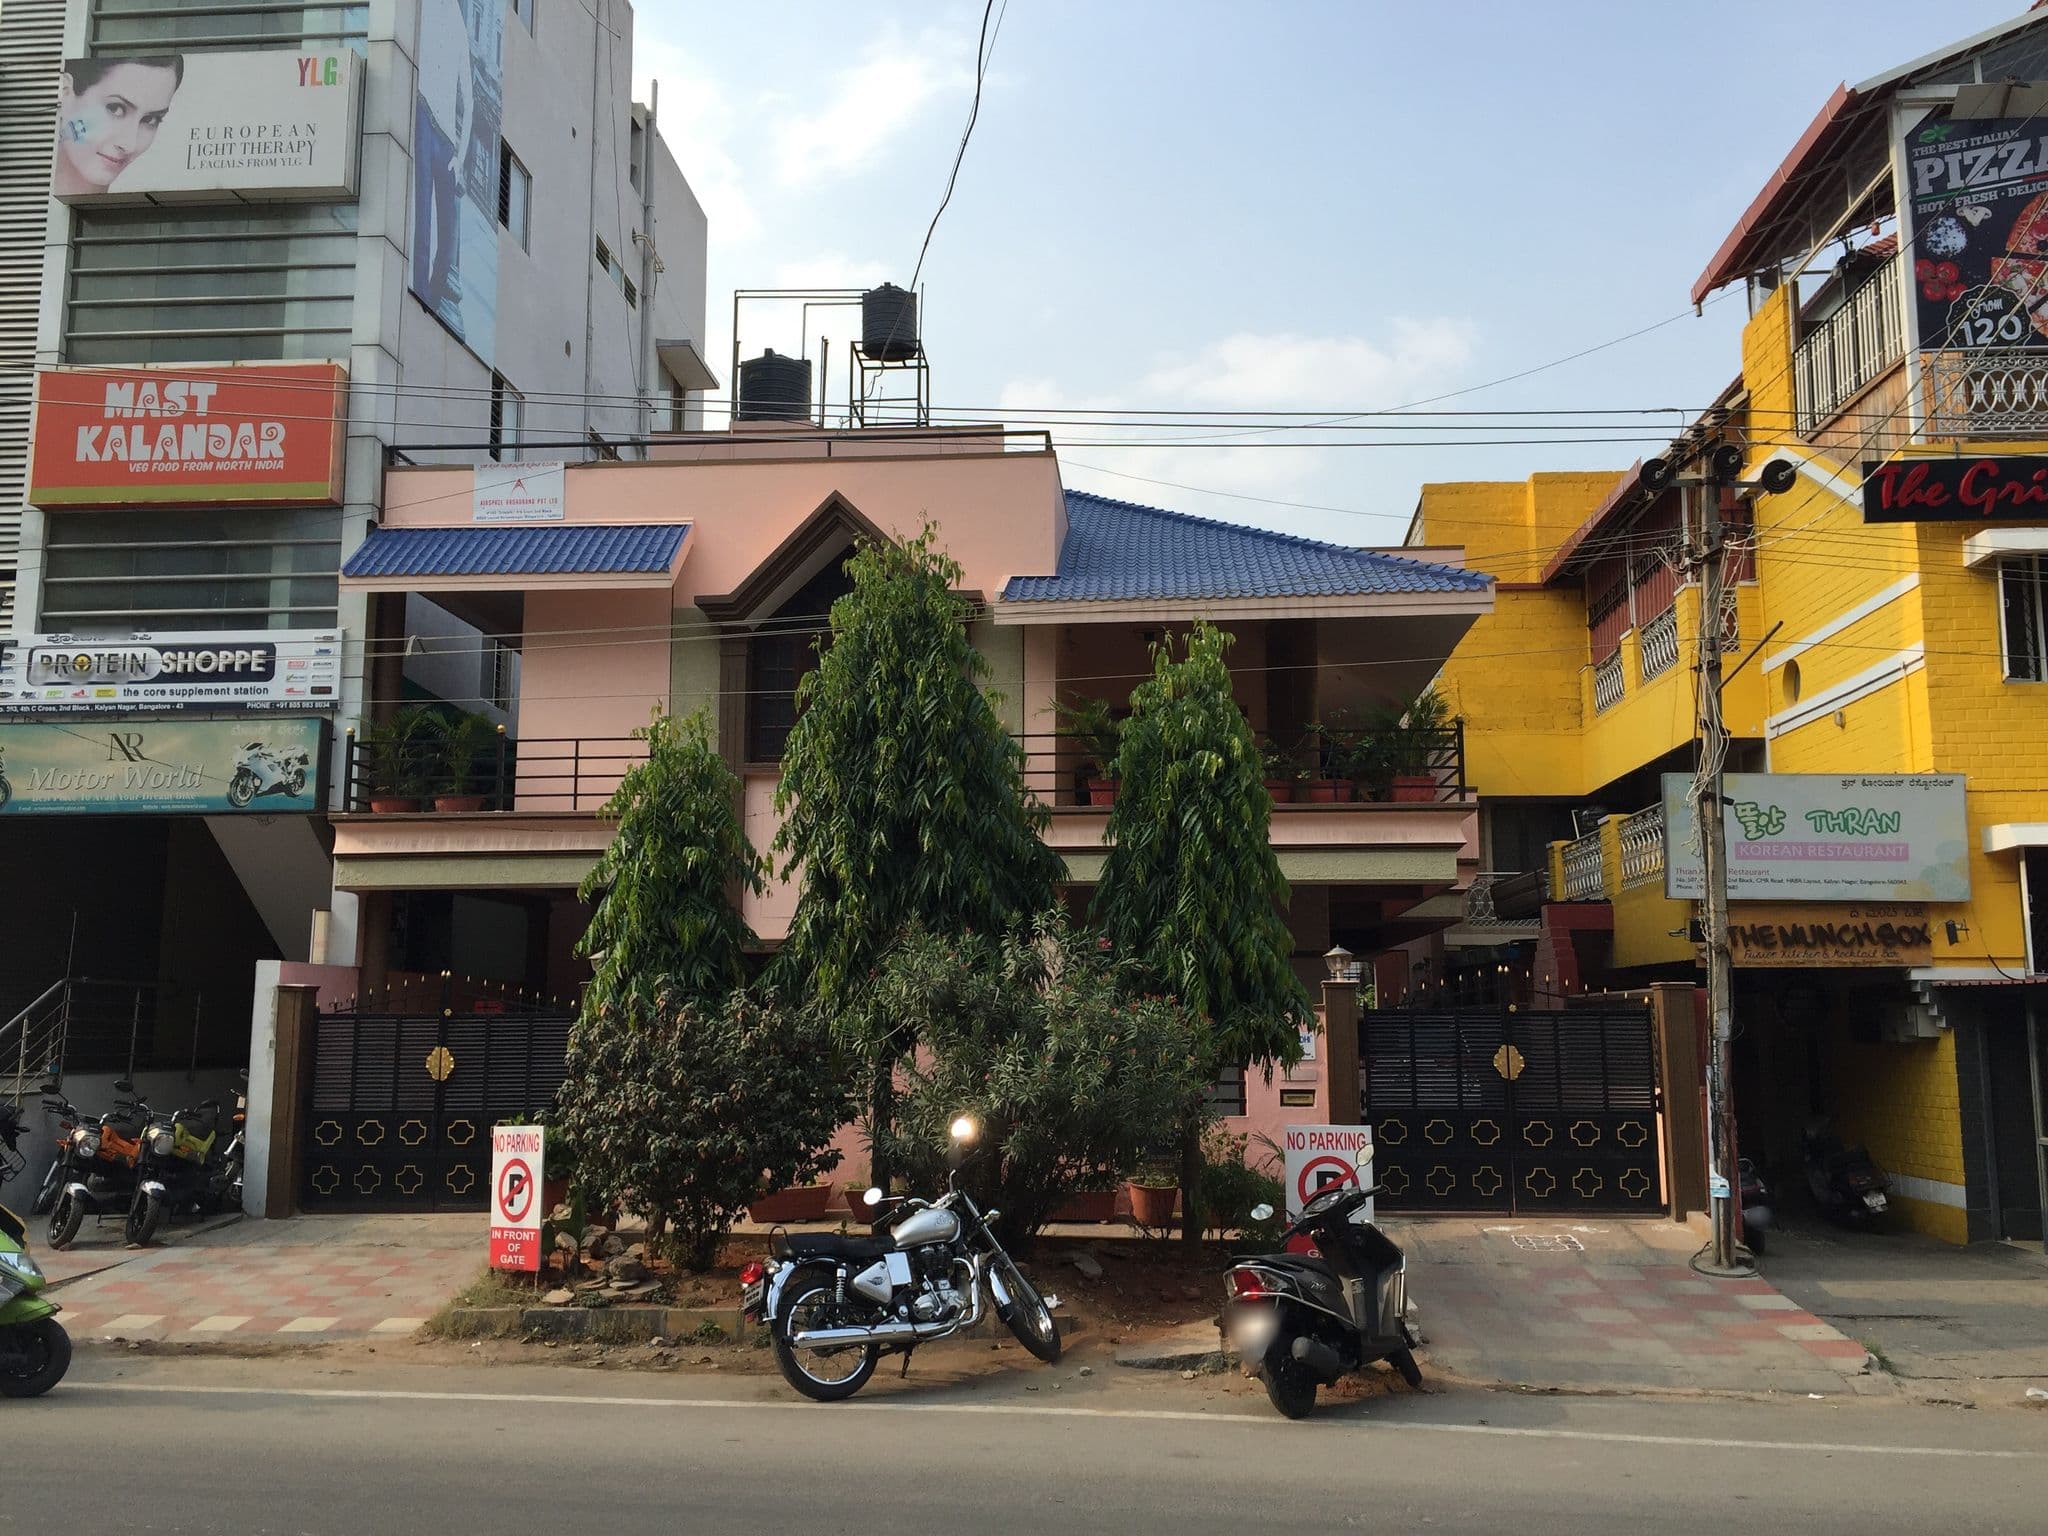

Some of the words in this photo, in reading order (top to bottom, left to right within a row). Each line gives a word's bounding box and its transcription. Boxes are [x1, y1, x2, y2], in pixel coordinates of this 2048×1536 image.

[297, 57, 338, 87] YLG
[190, 123, 317, 140] EUROPEAN
[240, 140, 317, 166] THERAPY
[1912, 145, 1937, 157] THE
[1970, 129, 2020, 147] ITALIAN
[199, 159, 244, 169] FACIALS
[247, 157, 277, 168] FROM
[280, 157, 302, 167] YLG
[1917, 200, 1946, 214] HOT
[1955, 190, 1999, 208] FRESH
[1966, 297, 2004, 319] From
[1959, 314, 2023, 347] 120
[104, 381, 218, 418] MAST
[75, 422, 286, 462] KALANDAR
[129, 463, 148, 473] VEG
[151, 462, 180, 473] FOOD
[182, 461, 213, 472] FROM
[216, 461, 251, 471] NORTH
[254, 460, 284, 470] INDIA
[1874, 462, 1950, 511] The
[161, 649, 268, 673] SHOPPE
[123, 687, 139, 697] the
[143, 688, 166, 697] core
[169, 686, 230, 698] supplement
[234, 685, 269, 696] station
[139, 703, 171, 711] Bangalore
[25, 767, 115, 791] Motor
[122, 763, 205, 790] World
[1805, 807, 1901, 836] THRAN
[1740, 844, 1802, 857] KOREAN
[1808, 845, 1905, 857] RESTAURANT
[1728, 867, 1770, 876] Restaurant
[1726, 923, 1778, 948] THE
[1778, 922, 1878, 948] MUNCH
[1875, 922, 1933, 947] BOX
[494, 1134, 505, 1153] NO
[506, 1133, 540, 1153] PARKING
[1287, 1131, 1305, 1150] NO
[1309, 1131, 1366, 1151] PARKING
[491, 1229, 501, 1240] IN
[503, 1230, 536, 1241] FRONT
[507, 1243, 521, 1253] OF
[500, 1255, 525, 1265] GATE
